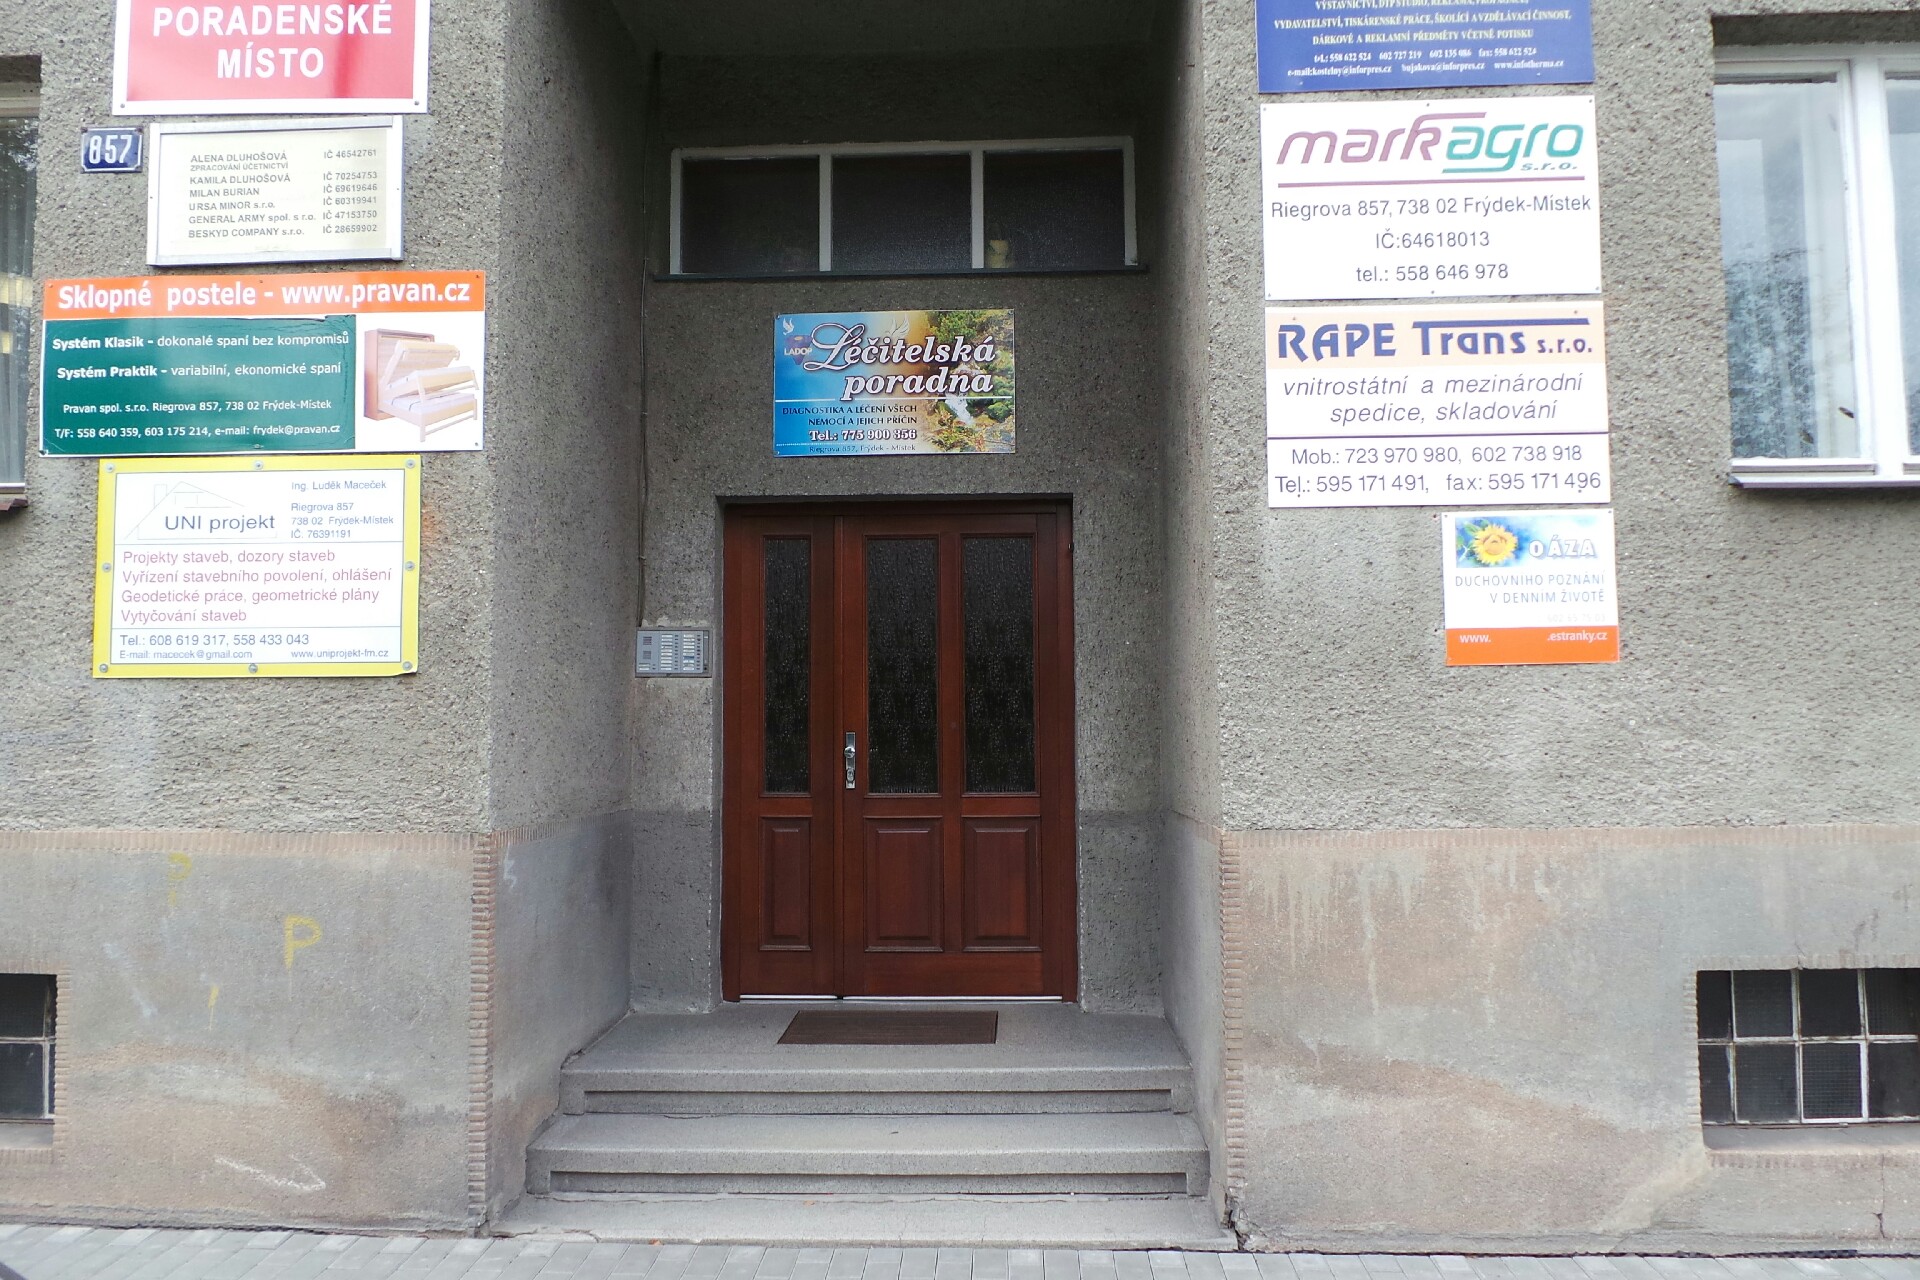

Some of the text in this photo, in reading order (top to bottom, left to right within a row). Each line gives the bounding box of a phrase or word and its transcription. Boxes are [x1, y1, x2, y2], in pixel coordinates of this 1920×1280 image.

[153, 0, 392, 37] PORADENSKÉ
[1275, 16, 1343, 29] VYDAVATELSTVÍ,
[1345, 15, 1400, 27] TISKÁRENSKÉ
[1404, 13, 1433, 25] PRÁCE,
[1478, 10, 1531, 22] VZDĚLÁVACÍ
[1533, 9, 1571, 20] ČINNOST,
[1313, 28, 1533, 45] DÁRKOVÉ REKLAMNÍ PŘEDMĚTY VČETNĚ POTISKU
[218, 42, 324, 79] MÍSTO
[89, 135, 132, 164] 857
[1277, 112, 1584, 173] markagro
[191, 149, 333, 163] ALENA DLUHOŠOVÁ IČ
[1521, 162, 1577, 171] s.r.o.
[190, 173, 291, 185] KAMILA DLUHOŠOVÁ
[190, 184, 333, 197] MILAN BURIAN IČ
[219, 196, 332, 210] MINOR IČ
[1272, 194, 1591, 222] Riegrova 857, 738 02 Frýdek-Místek
[189, 210, 332, 224] GENERAL ARMY spol. IČ
[188, 224, 332, 238] BESKYD COMPANY IČ
[1375, 228, 1489, 249] IČ:64618013
[1357, 264, 1508, 282] tel.: 558 646 978
[59, 281, 470, 312] Sklopné postele www.pravan.cz
[53, 330, 348, 350] Systém Klasik dokonalé spaní bez kompromisů
[804, 322, 995, 371] Léčitelská
[1279, 318, 1592, 362] RAPE Trans s.r.o.
[784, 347, 812, 356] LADOP
[57, 363, 341, 380] Systém Praktik variabilní, ekonomické spaní
[841, 367, 993, 400] poradna
[1284, 373, 1582, 395] vnitrostátní a mezinárodní
[63, 399, 331, 415] Pravan spol. s.r.o. Riegrova 857, 738 02 Frýdek-Místek
[783, 407, 844, 415] DIAGNOSTIKA
[856, 404, 886, 414] LÉČENÍ
[889, 404, 917, 413] VŠECH
[1330, 400, 1556, 426] spedice, skladování
[808, 417, 845, 426] NEMOCÍ
[856, 417, 884, 425] JEJICH
[887, 415, 917, 424] PŘÍČIN
[55, 424, 340, 439] T/F: 558 640 359, 603 175 214, e-mail: frydek@pravan.cz
[809, 429, 890, 441] Tel.: 775 900
[1292, 445, 1582, 465] Mob.: 723 970 980, 602 738 918
[312, 480, 386, 490] Luděk Maceček
[1275, 473, 1601, 493] Tel.: 595 171 491, fax: 595 171 496
[291, 503, 353, 513] Riegrova 857
[165, 515, 275, 533] UNI projekt
[291, 517, 308, 526] 738
[123, 550, 335, 565] Projekty staveb, dozory staveb
[123, 568, 391, 585] Vyřízení stavebního povolení, ohlášení
[1455, 571, 1605, 586] DUCHOVNÍHO POZNÁNÍ
[122, 588, 379, 604] Geodetické práce, geometrické plány
[1490, 589, 1604, 603] V DENNÍM ŽIVOTĚ
[121, 609, 246, 624] Vytyčování staveb
[120, 635, 309, 647] Tel.: 608 619 317, 558 433 043
[1460, 630, 1608, 643] www. .estranky.cz
[291, 649, 388, 660] www.uniprojekt-fm.cz
